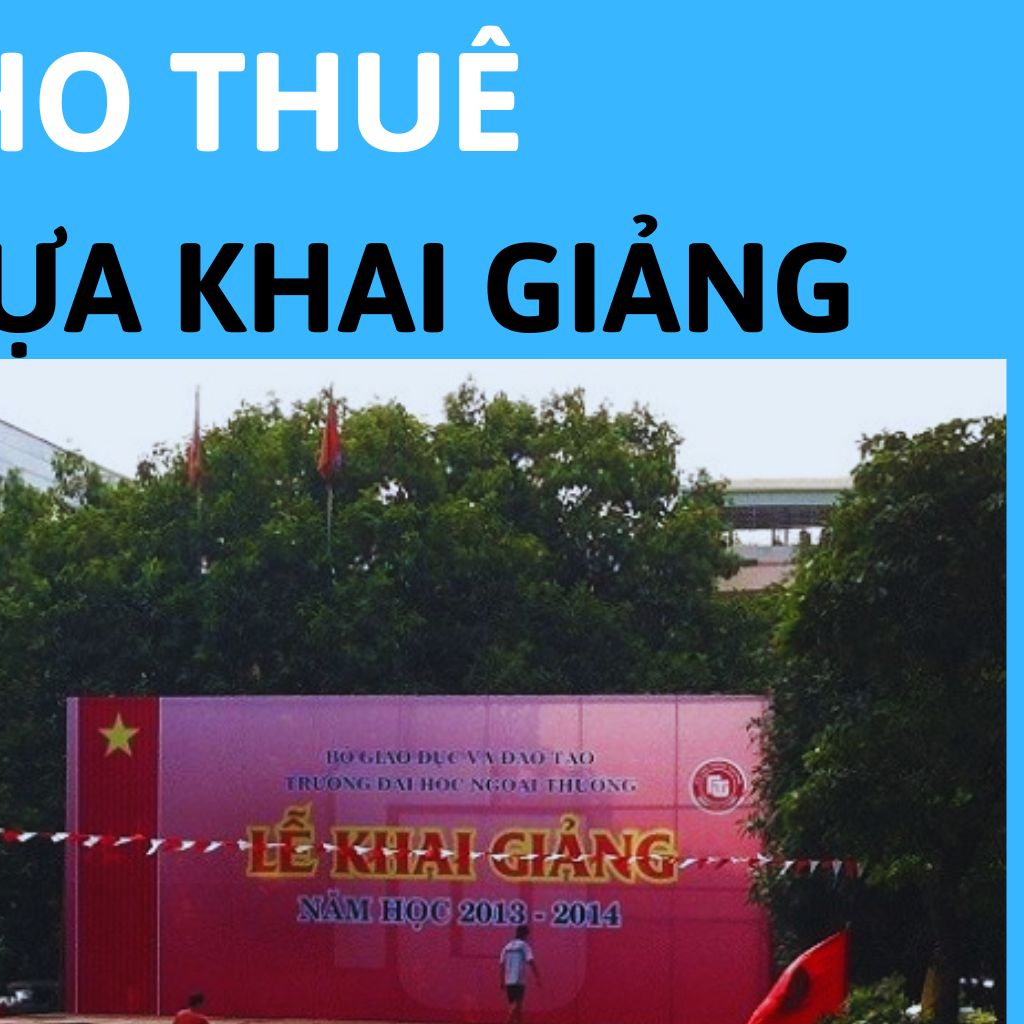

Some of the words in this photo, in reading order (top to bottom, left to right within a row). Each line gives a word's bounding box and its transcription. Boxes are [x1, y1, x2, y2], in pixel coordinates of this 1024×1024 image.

[331, 827, 475, 880] KHAI
[490, 813, 678, 884] GIẢNG
[380, 896, 453, 930] HỌC
[459, 900, 527, 926] 2013
[551, 900, 622, 928] 2014
